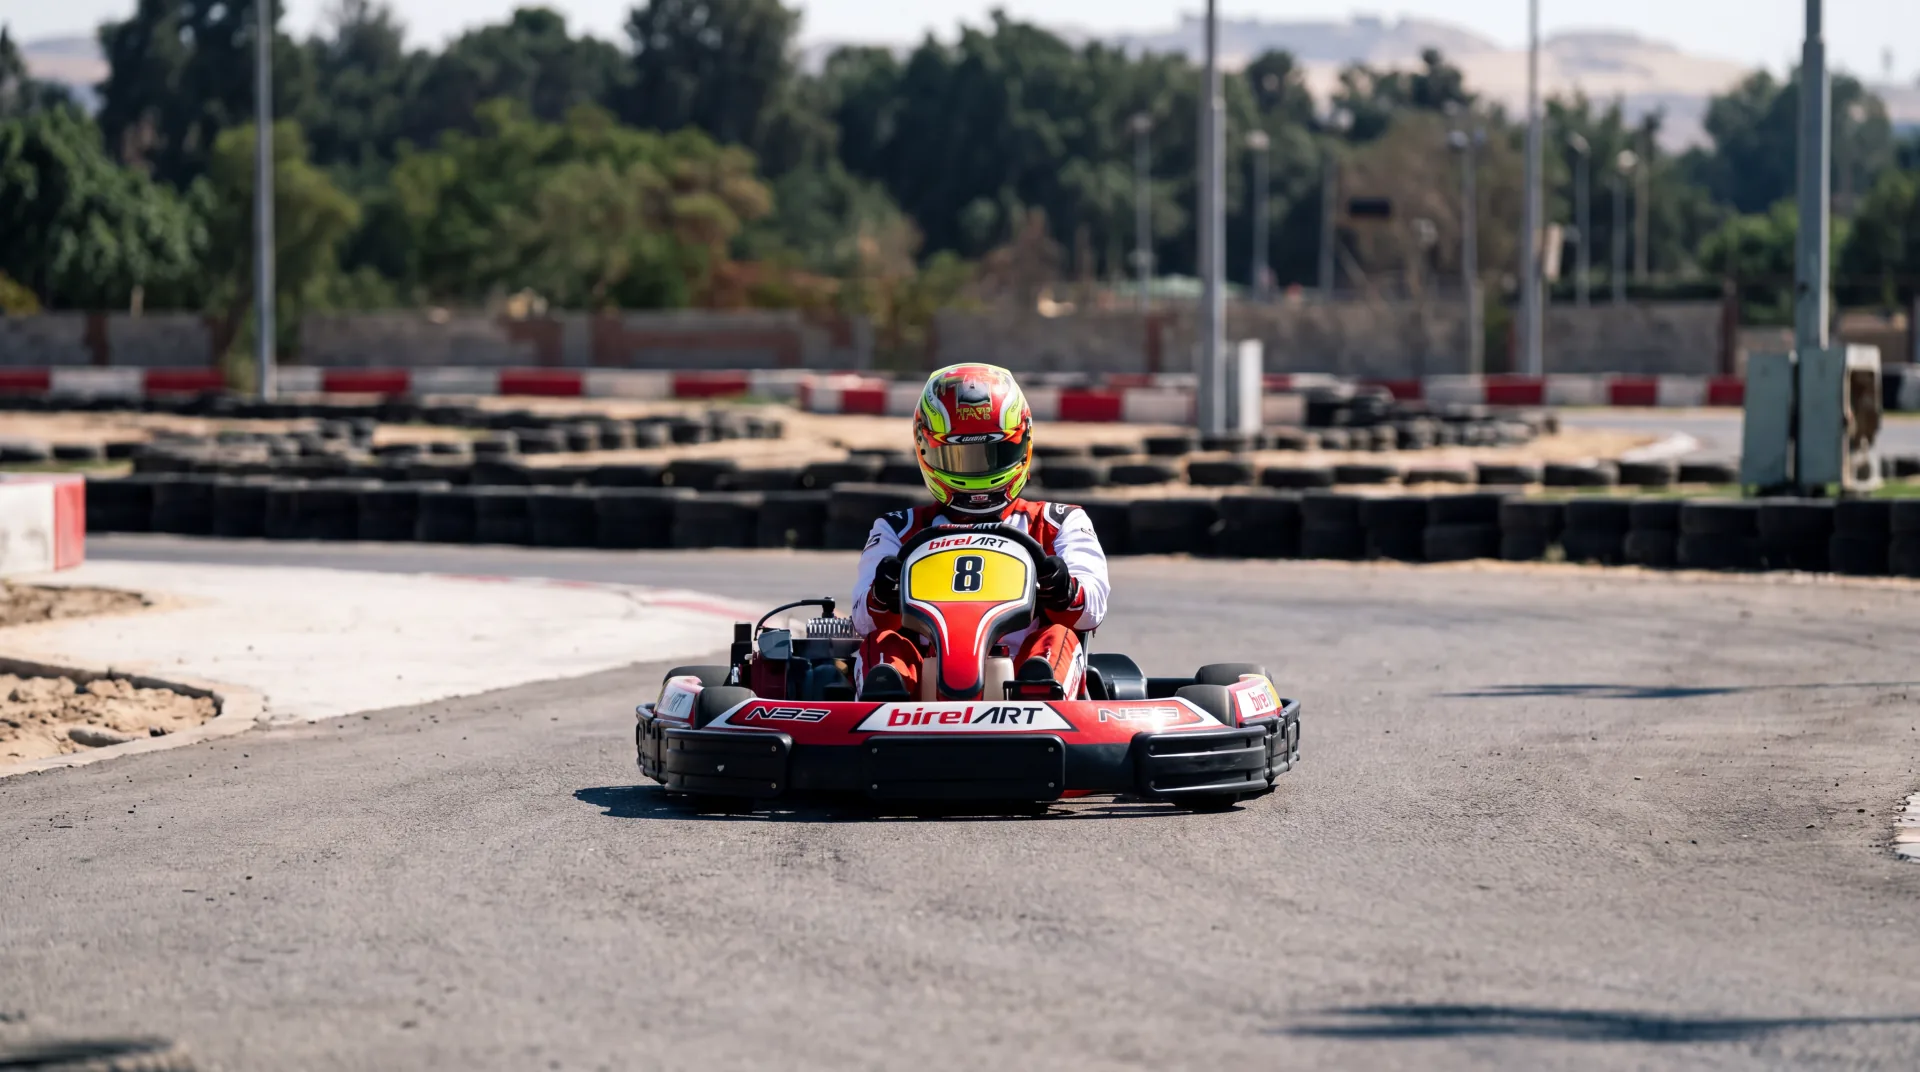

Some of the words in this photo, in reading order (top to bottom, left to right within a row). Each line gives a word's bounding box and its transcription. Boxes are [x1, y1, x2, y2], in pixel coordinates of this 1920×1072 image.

[928, 535, 1009, 550] birelART
[952, 556, 984, 592] 8
[887, 706, 1043, 727] birelART
